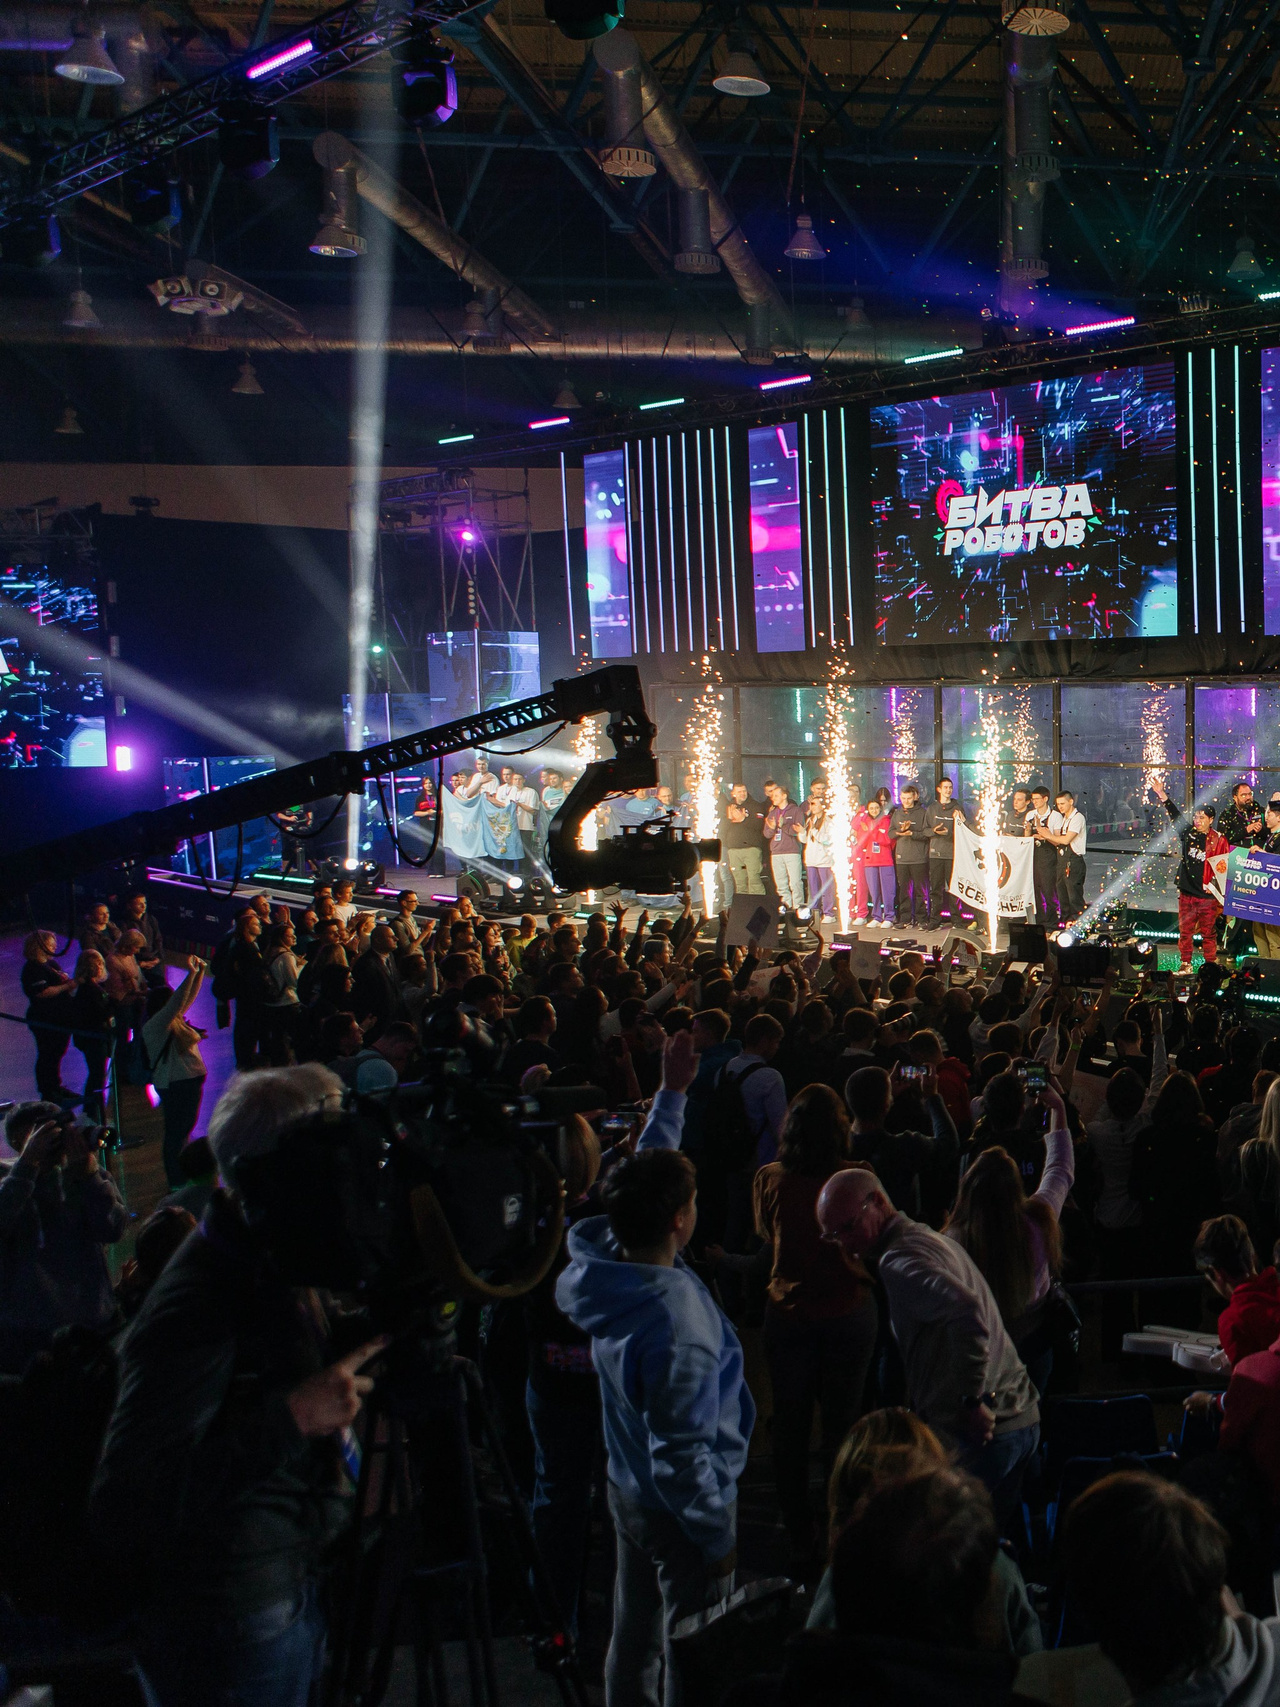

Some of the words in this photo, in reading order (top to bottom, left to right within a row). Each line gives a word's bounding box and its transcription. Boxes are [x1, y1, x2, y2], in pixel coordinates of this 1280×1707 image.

[944, 483, 1094, 529] БИТВА
[943, 517, 1087, 556] РОБОТОВ
[1234, 870, 1242, 882] 3
[1244, 872, 1269, 888] 000
[1237, 886, 1257, 895] место
